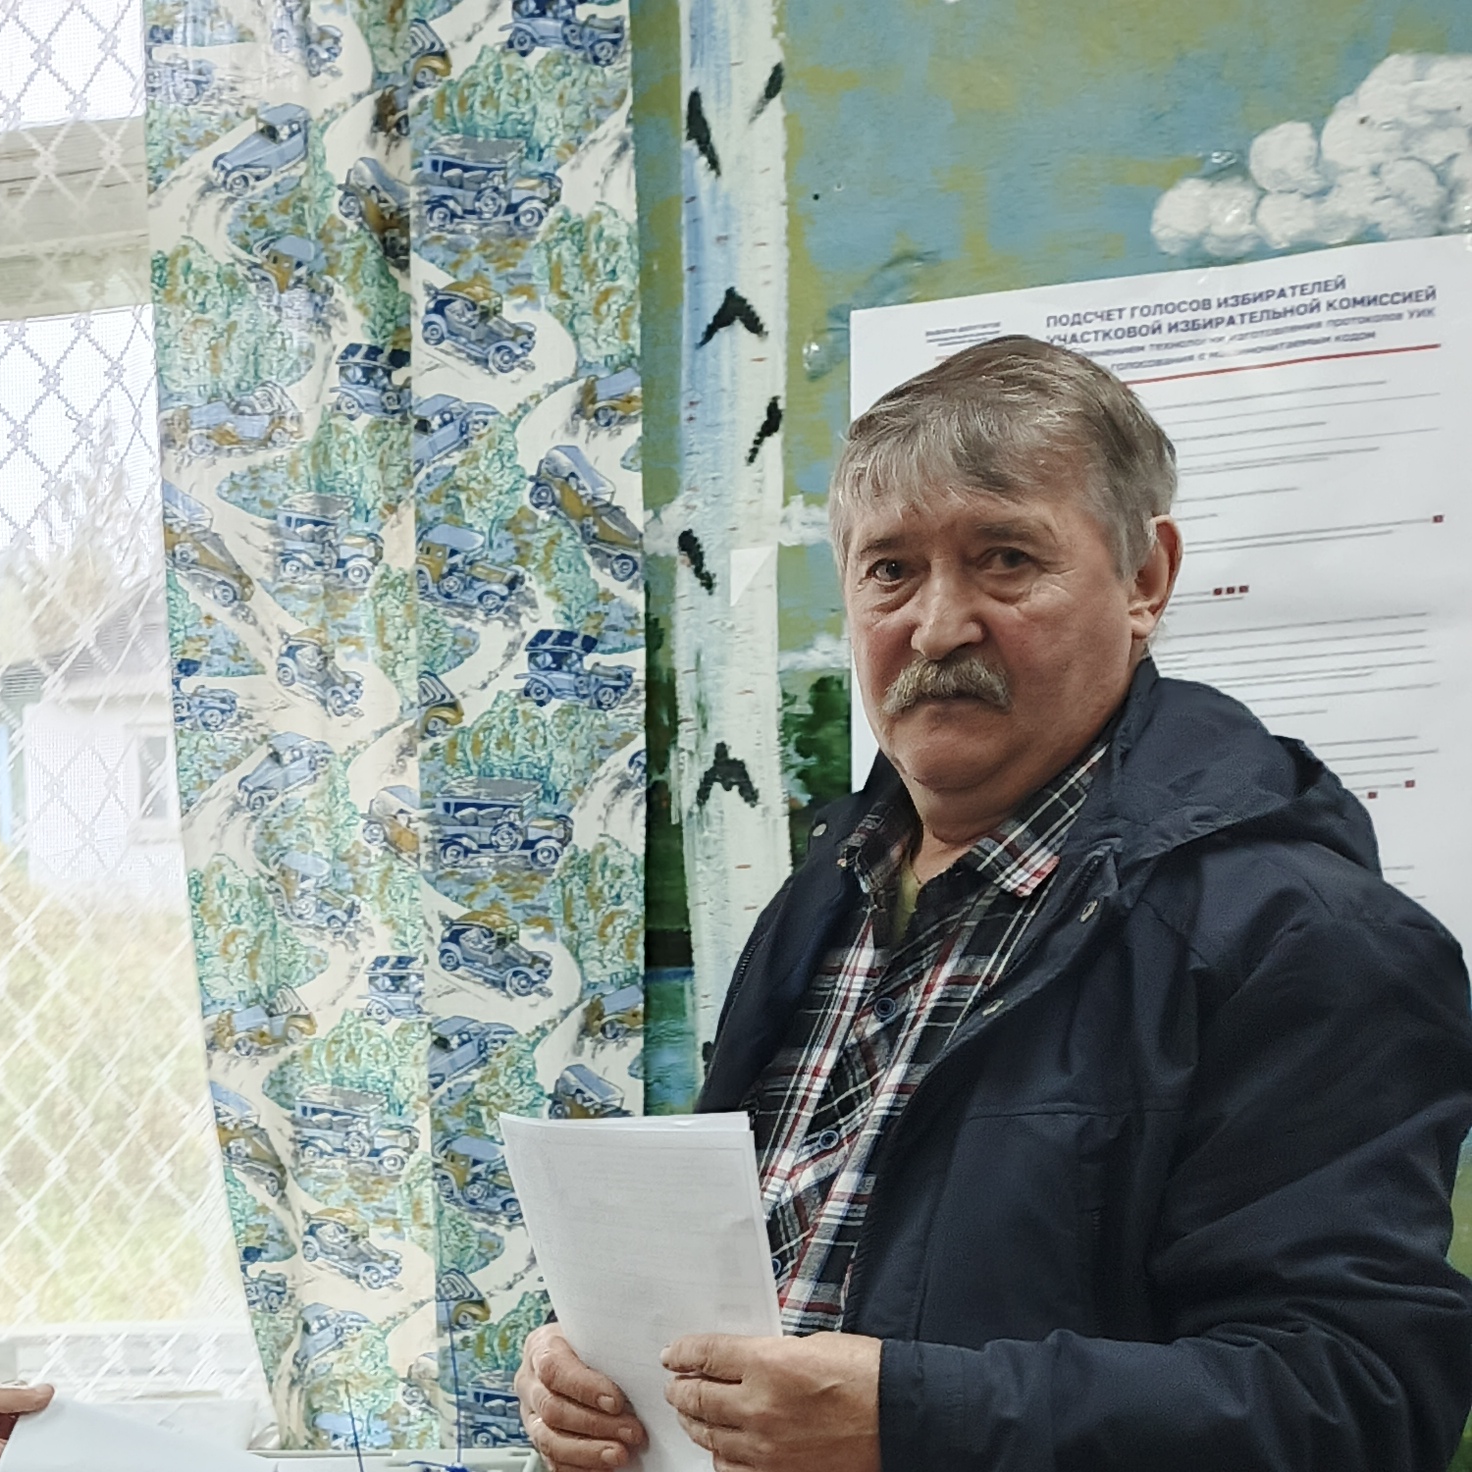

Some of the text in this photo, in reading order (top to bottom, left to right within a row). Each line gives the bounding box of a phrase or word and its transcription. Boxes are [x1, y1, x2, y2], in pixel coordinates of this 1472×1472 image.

[1046, 274, 1346, 328] ПОДСЧЕТ ГОЛОСОВ ИЗБИРАТЕЛЕЙ
[1167, 298, 1321, 334] ИЗБИРАТЕЛЬНОЙ
[1326, 285, 1437, 312] КОМИССИЕЙ
[1407, 307, 1436, 319] УИК
